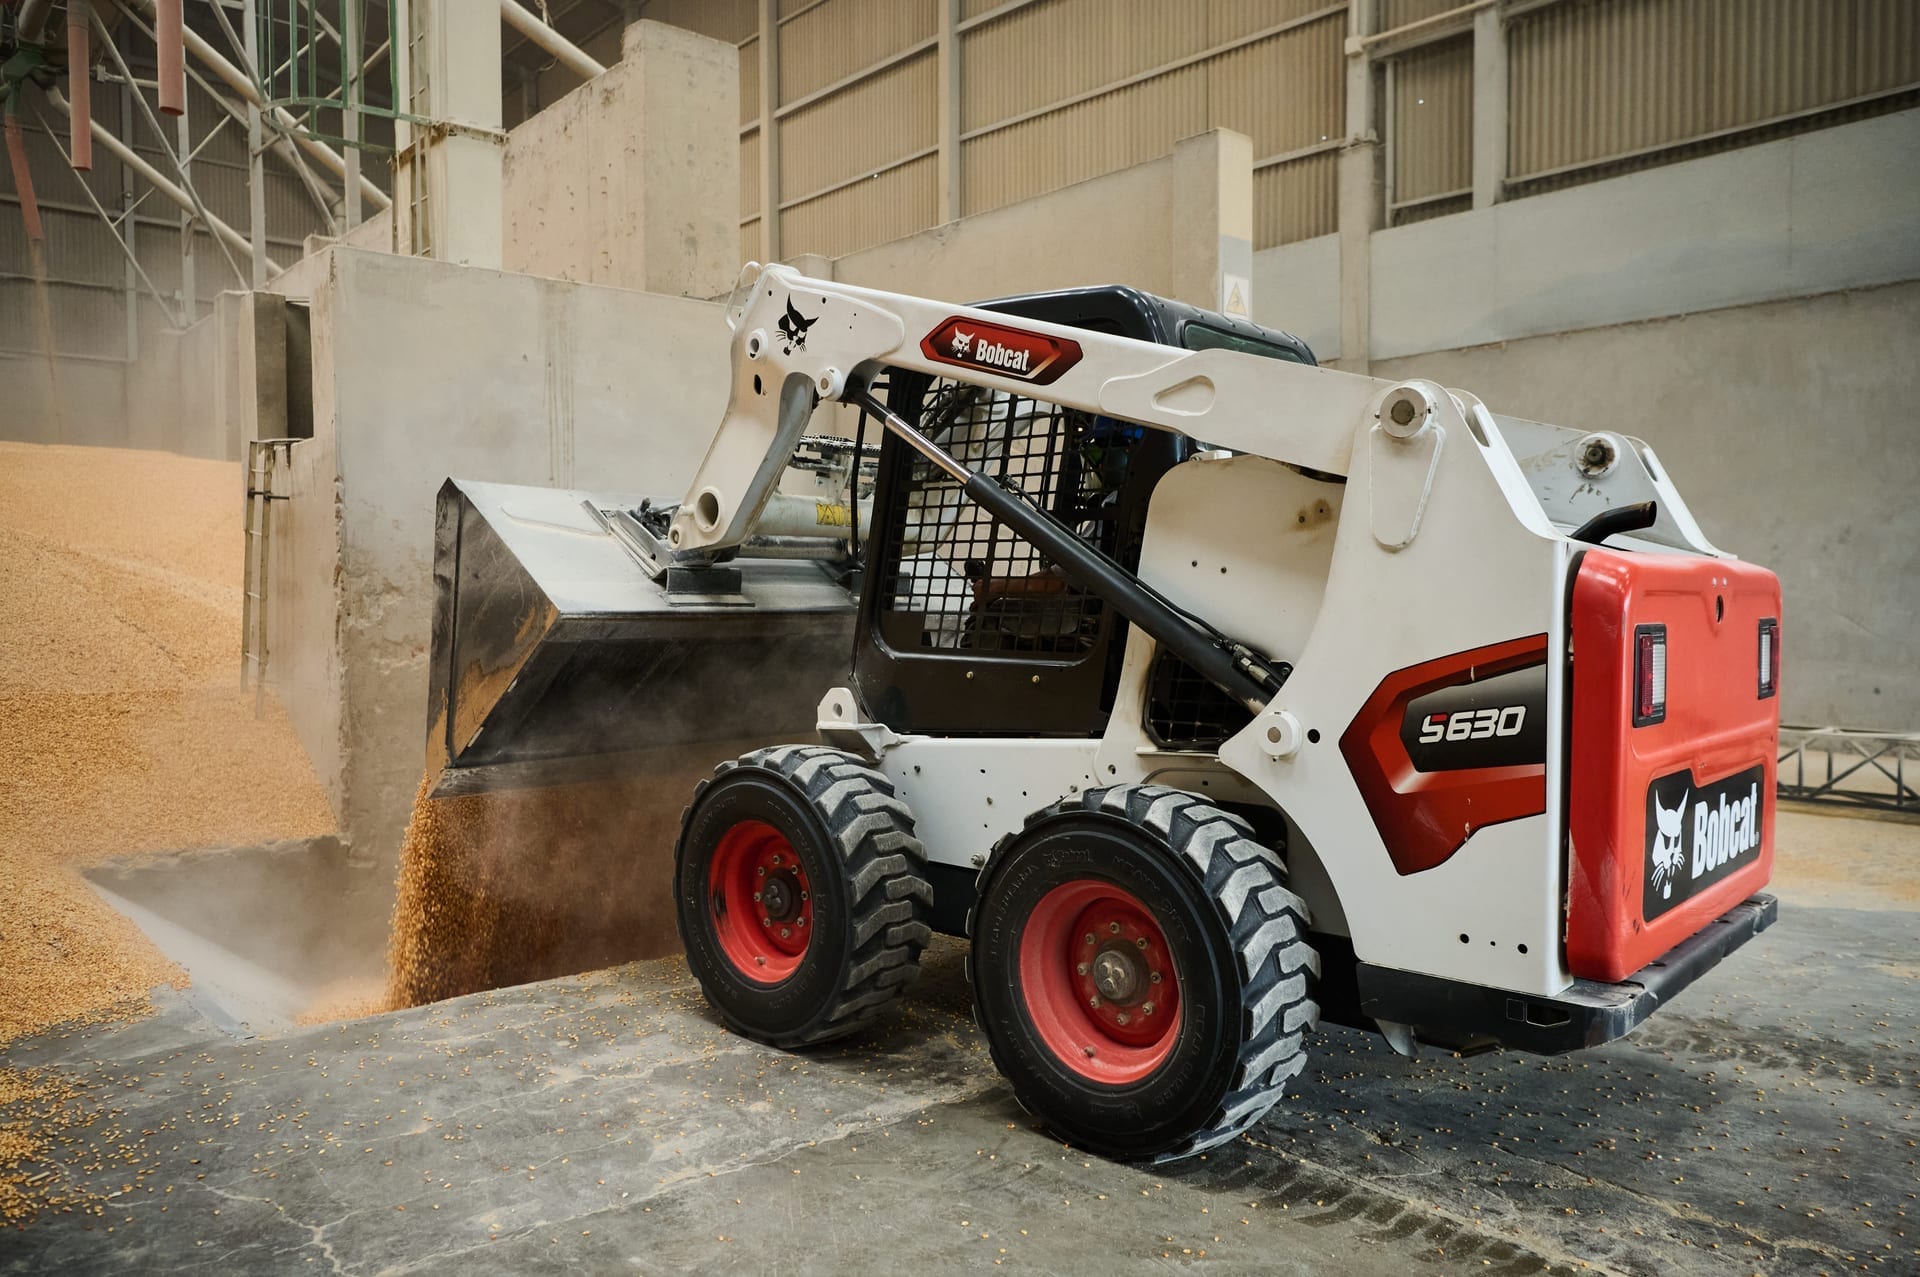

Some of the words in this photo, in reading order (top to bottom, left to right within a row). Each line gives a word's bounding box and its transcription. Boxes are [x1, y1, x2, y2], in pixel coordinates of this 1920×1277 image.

[976, 339, 1029, 371] Bobcat
[1419, 706, 1527, 743] S630
[1692, 782, 1758, 879] Bobcat
